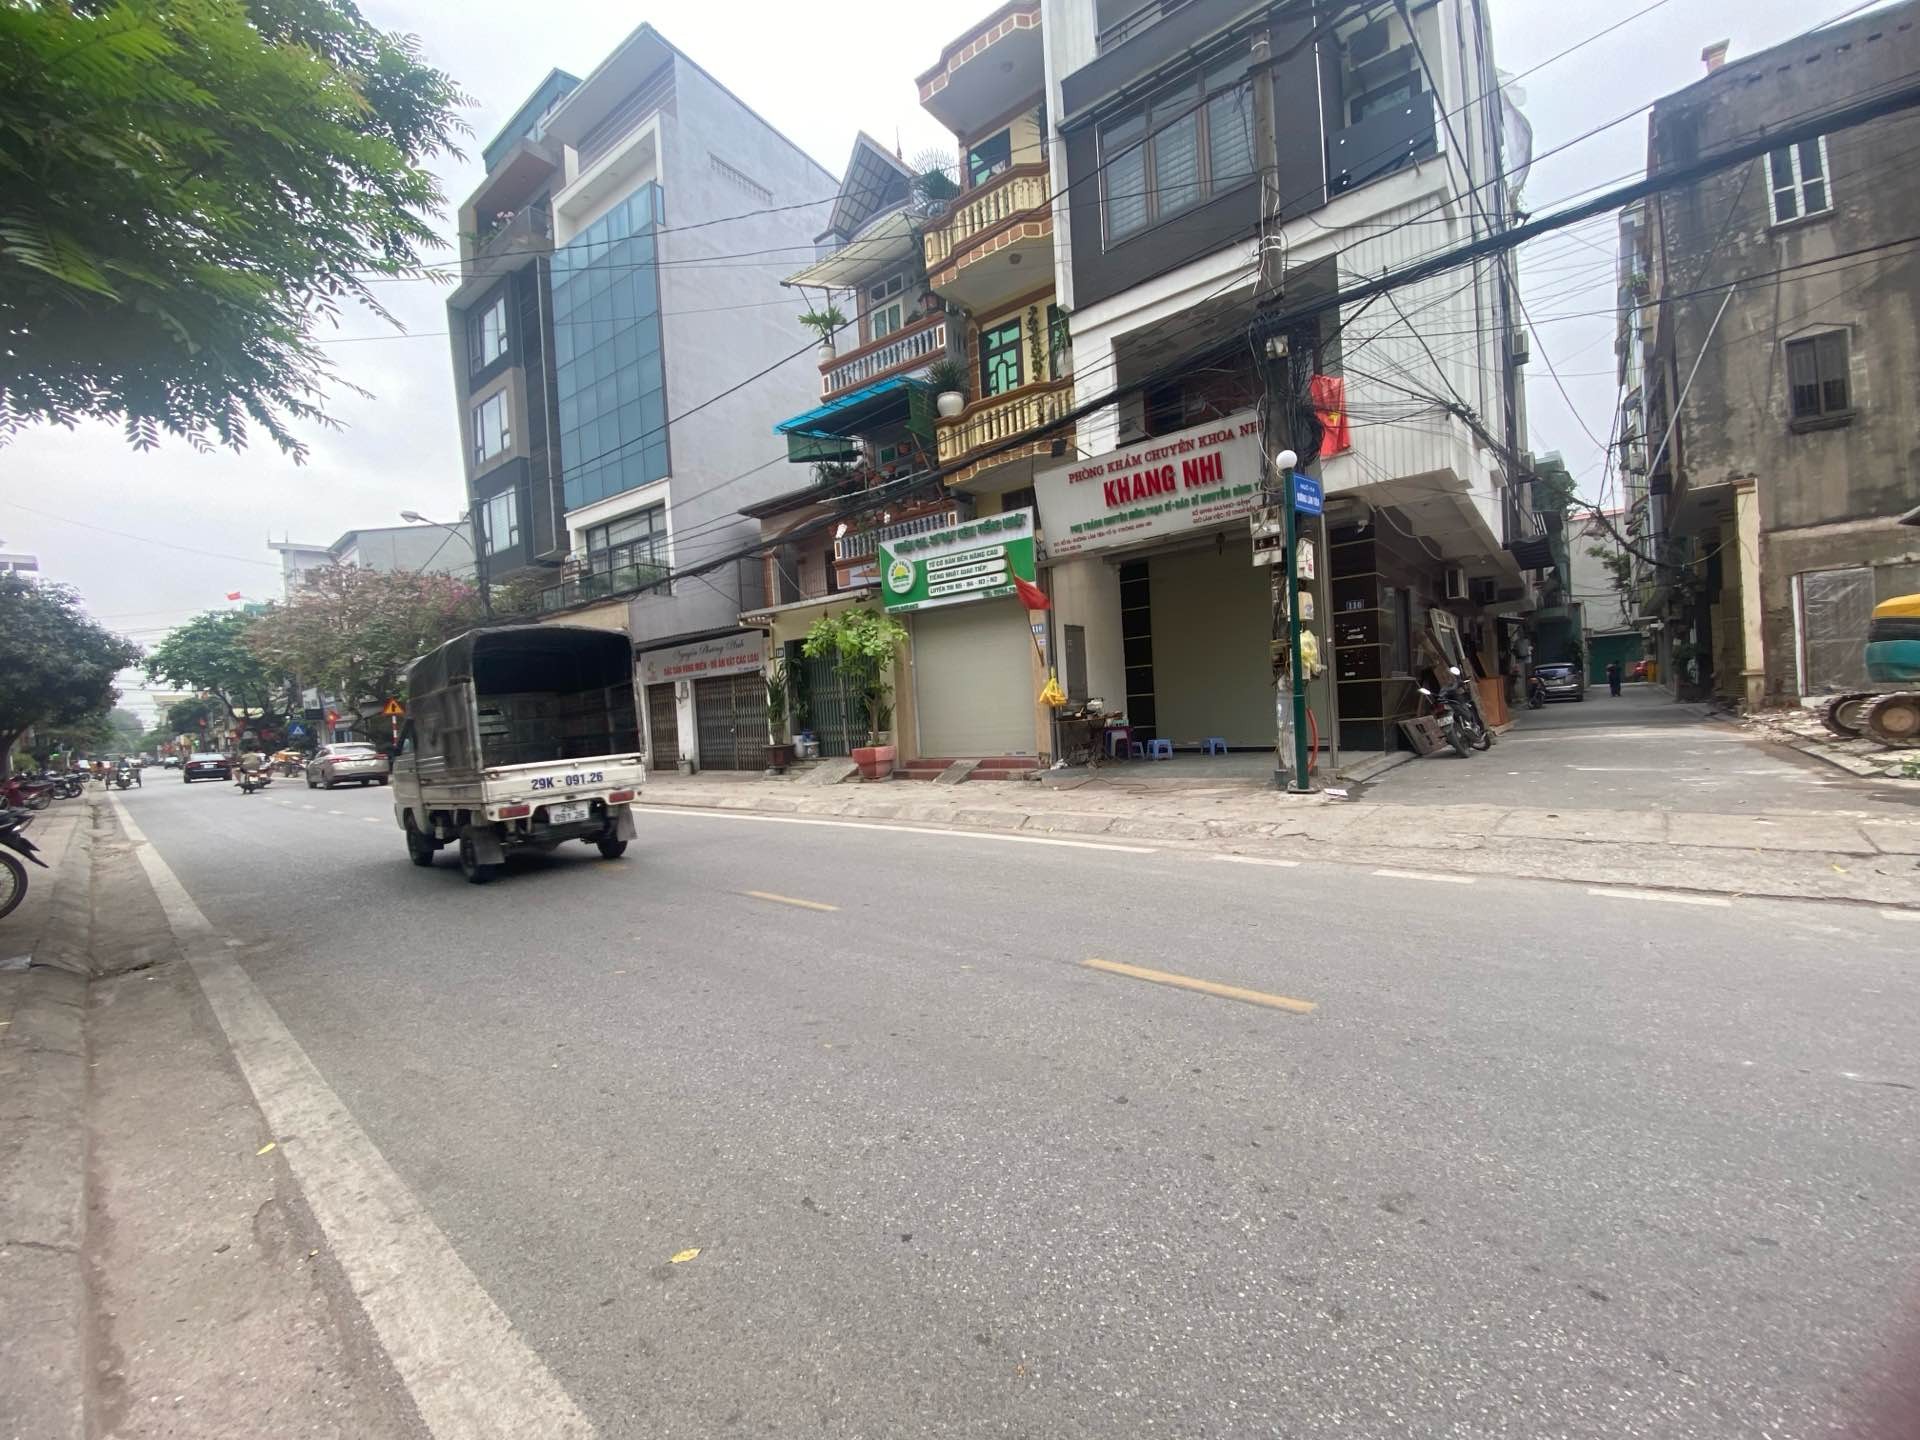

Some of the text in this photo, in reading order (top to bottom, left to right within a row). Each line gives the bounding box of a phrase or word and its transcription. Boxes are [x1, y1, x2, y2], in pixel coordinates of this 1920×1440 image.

[1068, 462, 1105, 485] PHÒNG
[1107, 453, 1142, 475] KHÁM
[1144, 437, 1195, 463] CHUYÊN
[1199, 430, 1235, 449] KHOA
[1103, 451, 1223, 508] KHANG NHI
[531, 777, 555, 790] 29K
[565, 771, 603, 786] 091.26
